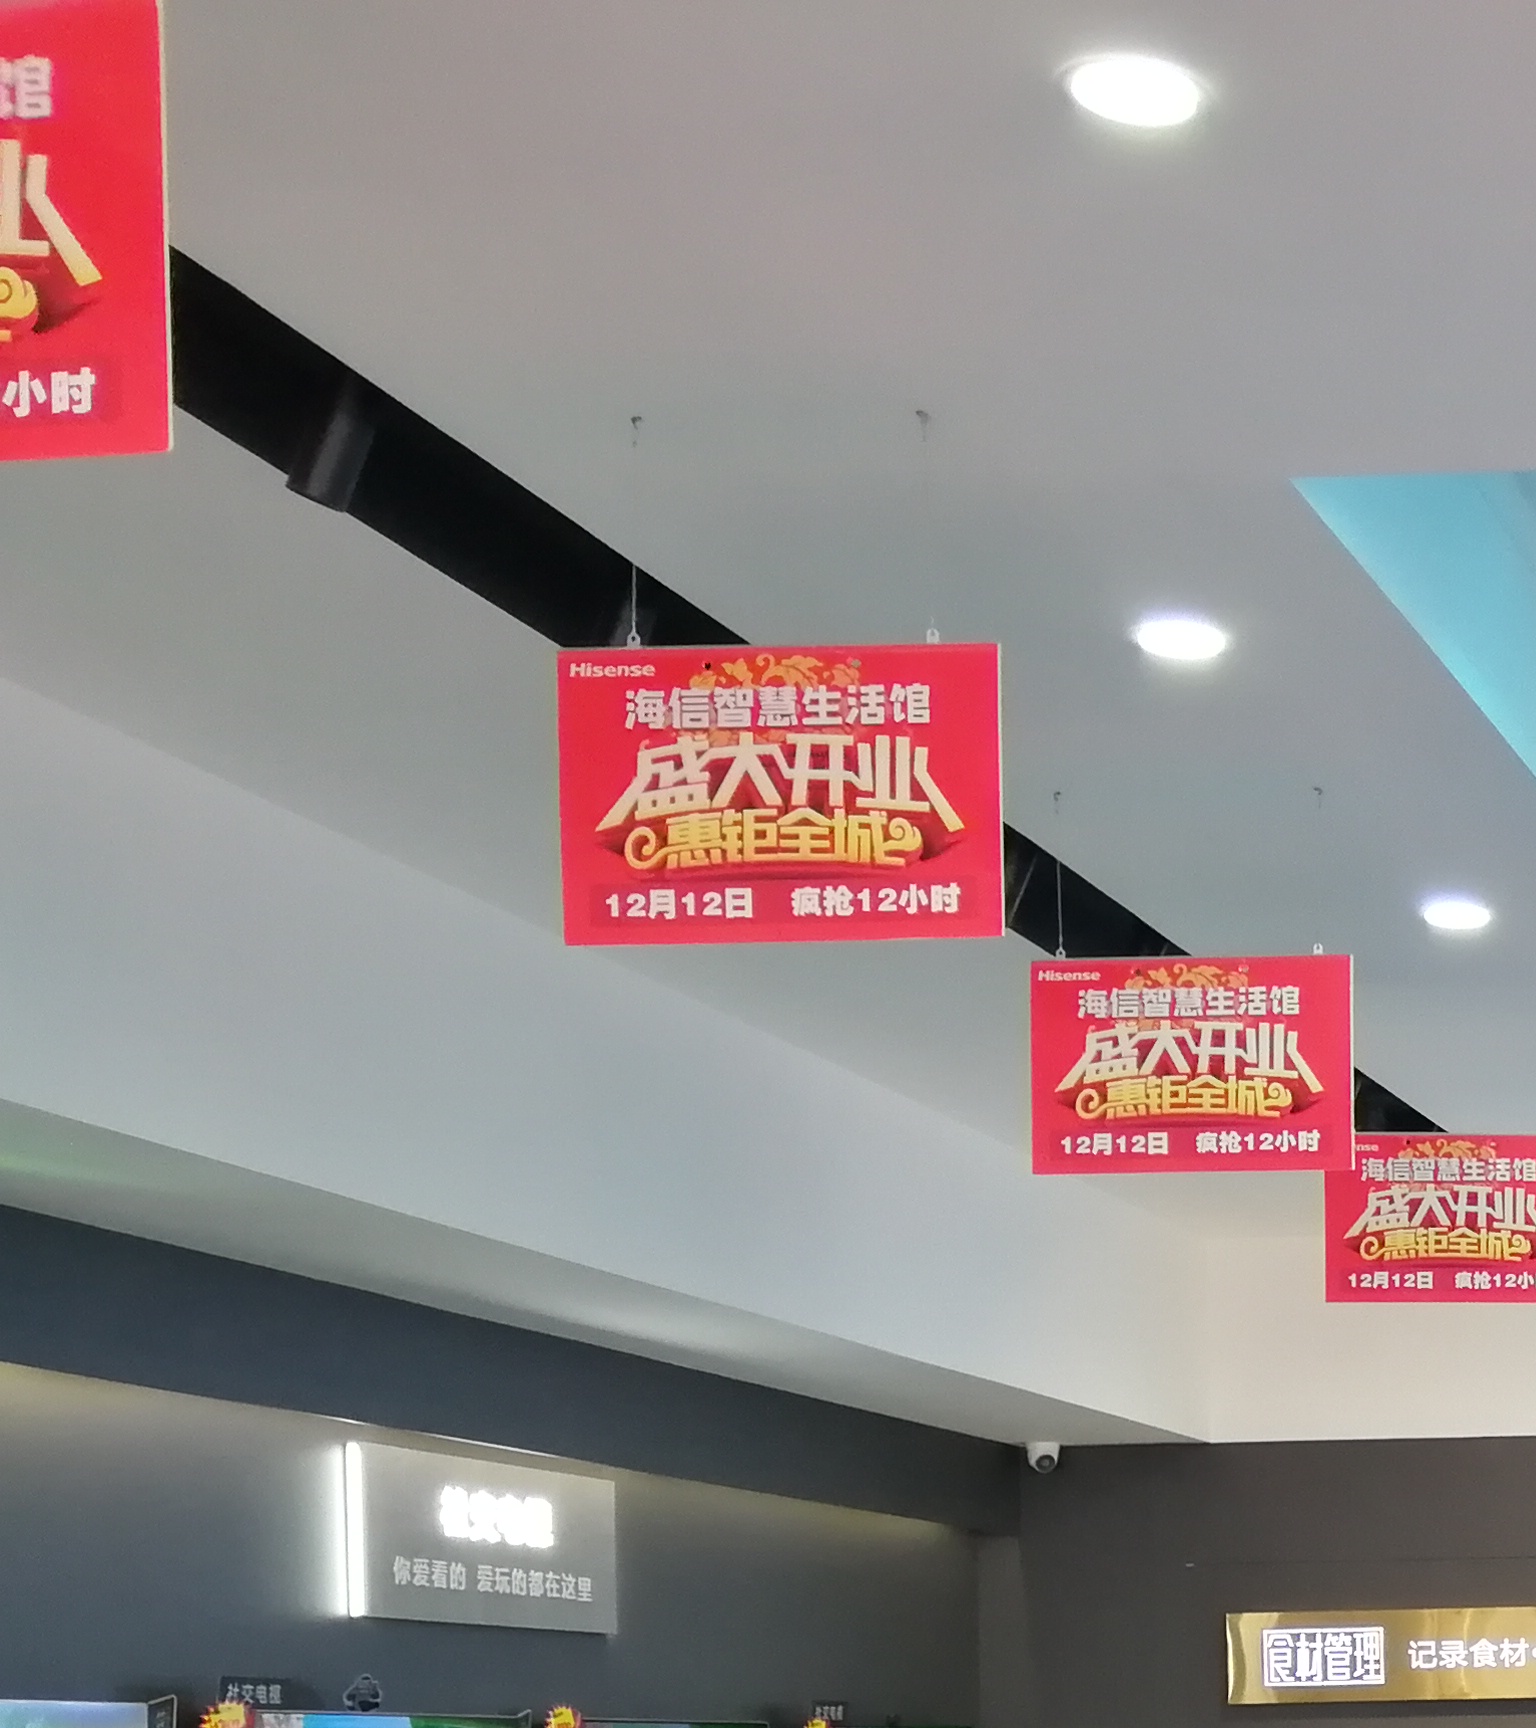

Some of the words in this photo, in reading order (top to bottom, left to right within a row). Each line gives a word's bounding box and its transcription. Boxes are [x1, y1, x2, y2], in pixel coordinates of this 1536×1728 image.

[568, 661, 656, 679] Hisense
[624, 682, 931, 730] 海信智慧生活馆
[595, 731, 965, 832] 盛大开业
[623, 807, 922, 870] 惠钜全城
[605, 886, 754, 921] 12月12日
[790, 881, 962, 917] 疯抢12小时
[1037, 969, 1102, 983] Hisense
[1077, 984, 1300, 1019] 海信智慧生活馆
[1053, 1020, 1325, 1094] 盛大开业
[1074, 1075, 1293, 1120] 惠钜全城
[1060, 1131, 1169, 1156] 12月12日
[1195, 1128, 1322, 1155] 疯抢12小时
[1359, 1227, 1533, 1262] 惠钜全城
[1347, 1271, 1435, 1291] 12月12日
[393, 1555, 467, 1591] 你爱看的
[476, 1563, 594, 1603] 爱玩的都在这里
[1265, 1631, 1383, 1683] 食材管理
